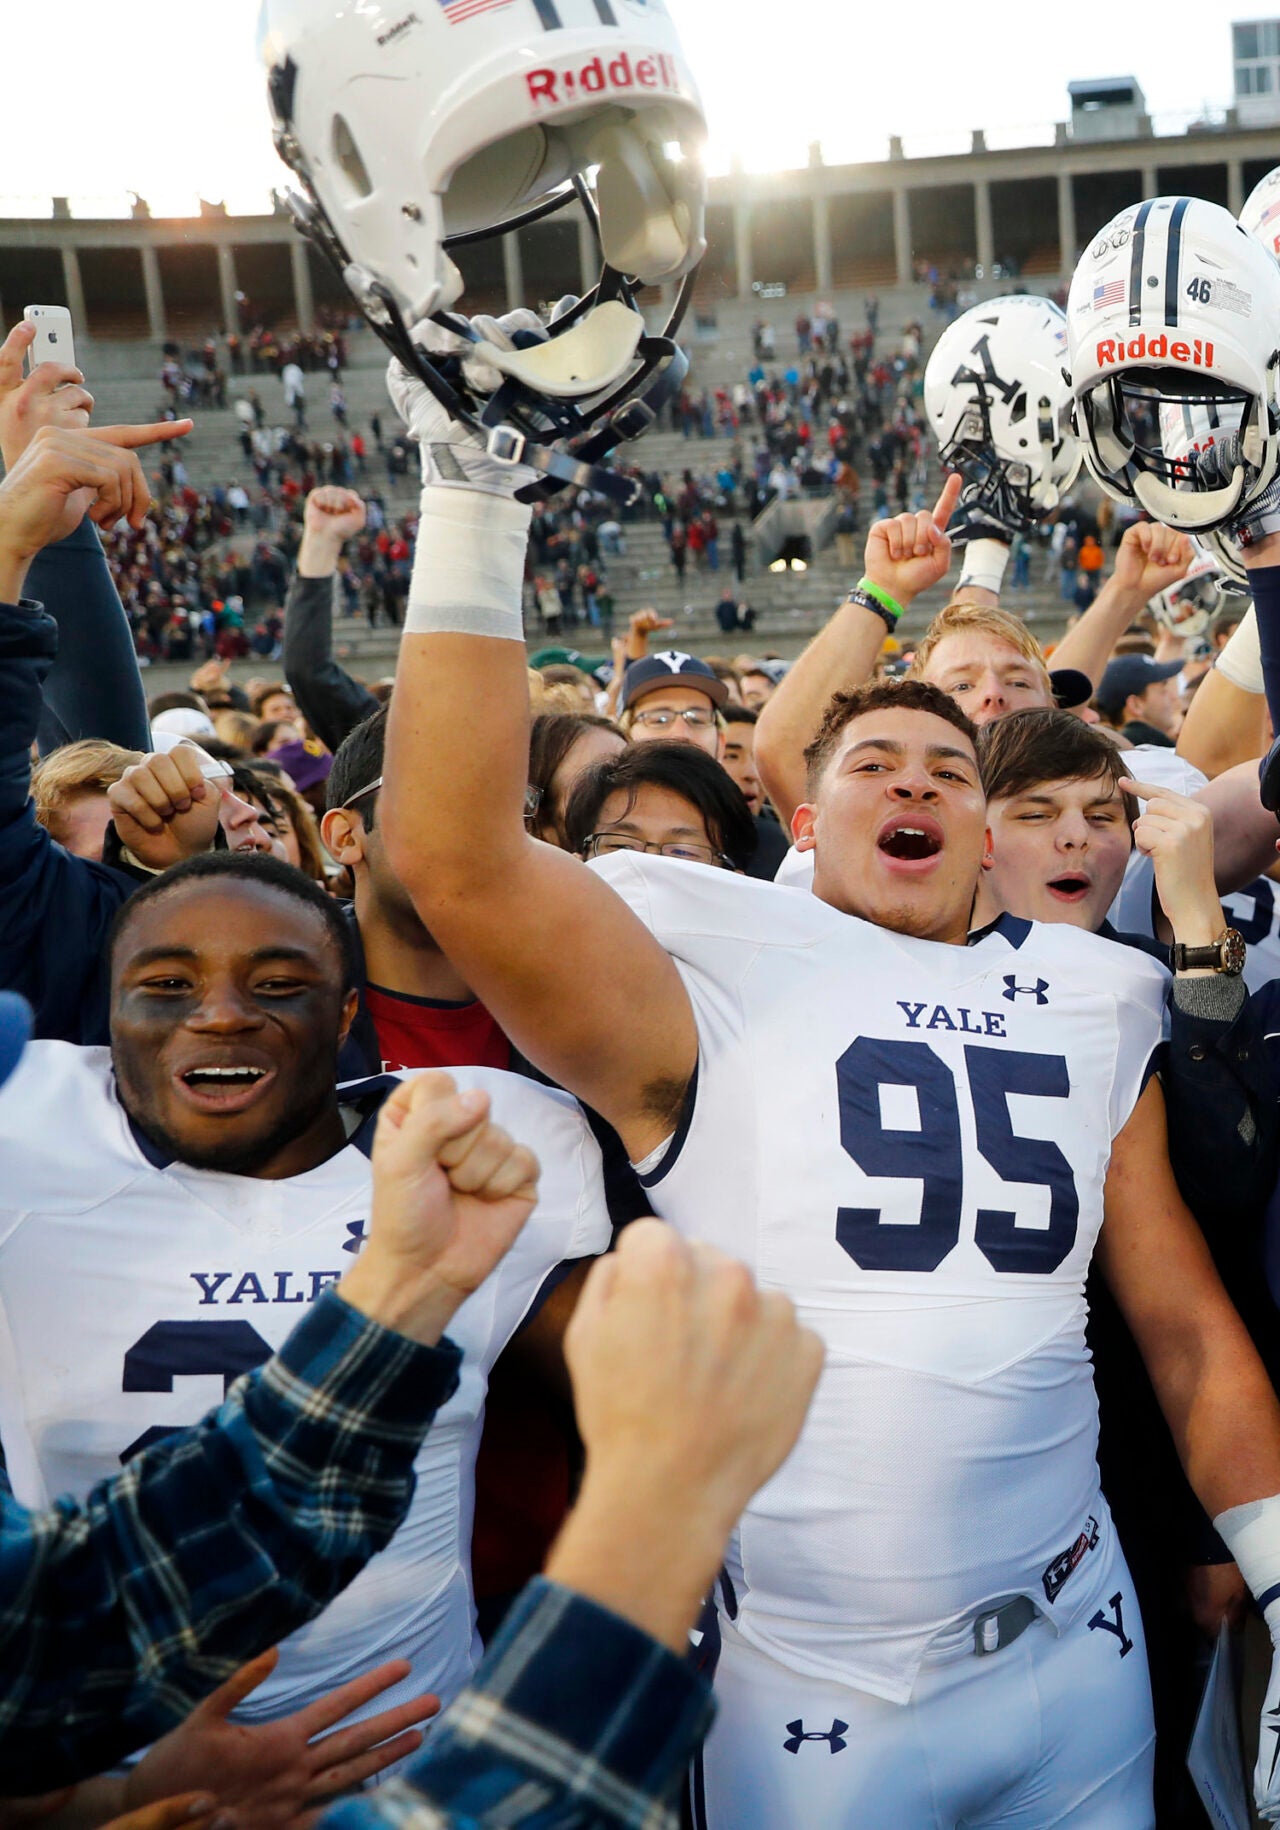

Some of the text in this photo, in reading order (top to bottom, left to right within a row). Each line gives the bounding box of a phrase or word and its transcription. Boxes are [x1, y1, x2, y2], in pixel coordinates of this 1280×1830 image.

[1187, 278, 1212, 303] 46
[1096, 333, 1214, 368] Riddell
[653, 650, 691, 674] Y
[896, 1001, 1007, 1037] YALE
[835, 1035, 1079, 1274] 95
[1087, 1591, 1134, 1659] Y
